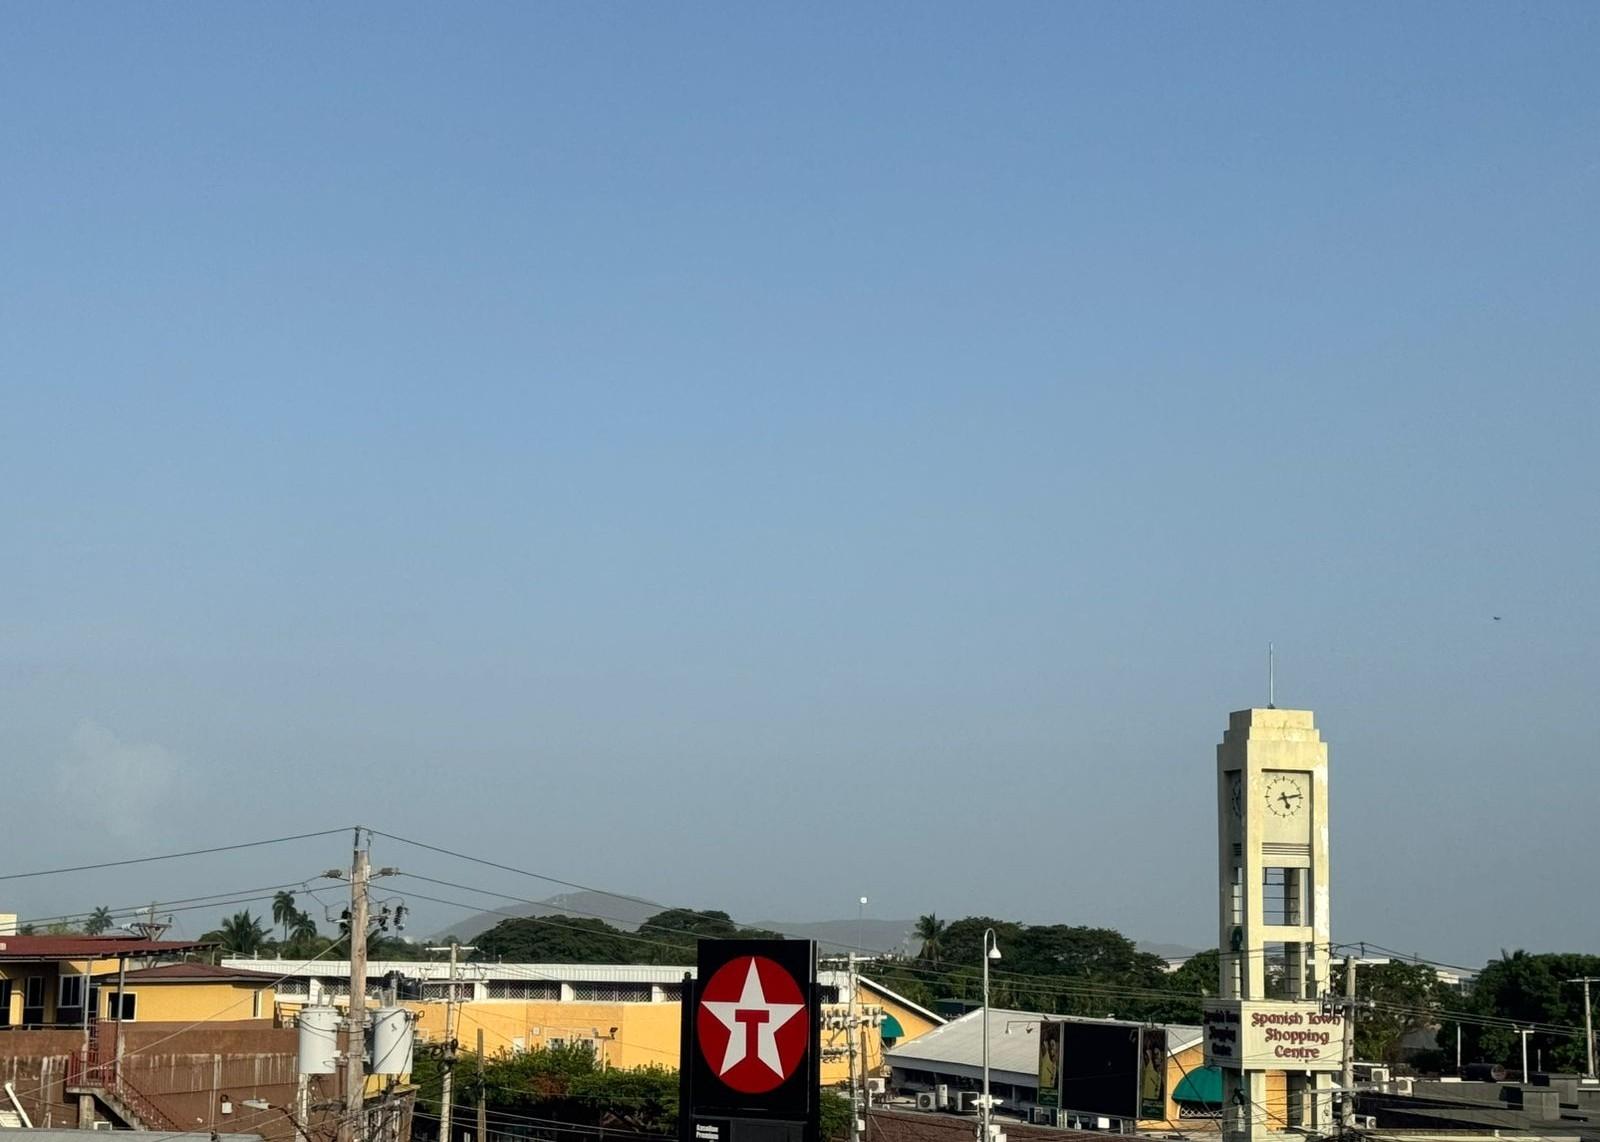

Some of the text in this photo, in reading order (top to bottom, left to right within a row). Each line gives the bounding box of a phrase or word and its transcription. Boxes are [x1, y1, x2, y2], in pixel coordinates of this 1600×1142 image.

[1251, 1011, 1303, 1027] Spanish
[1306, 1012, 1341, 1026] Town
[735, 1009, 770, 1060] T
[1265, 1028, 1330, 1044] Shopping
[1274, 1045, 1320, 1058] Centre
